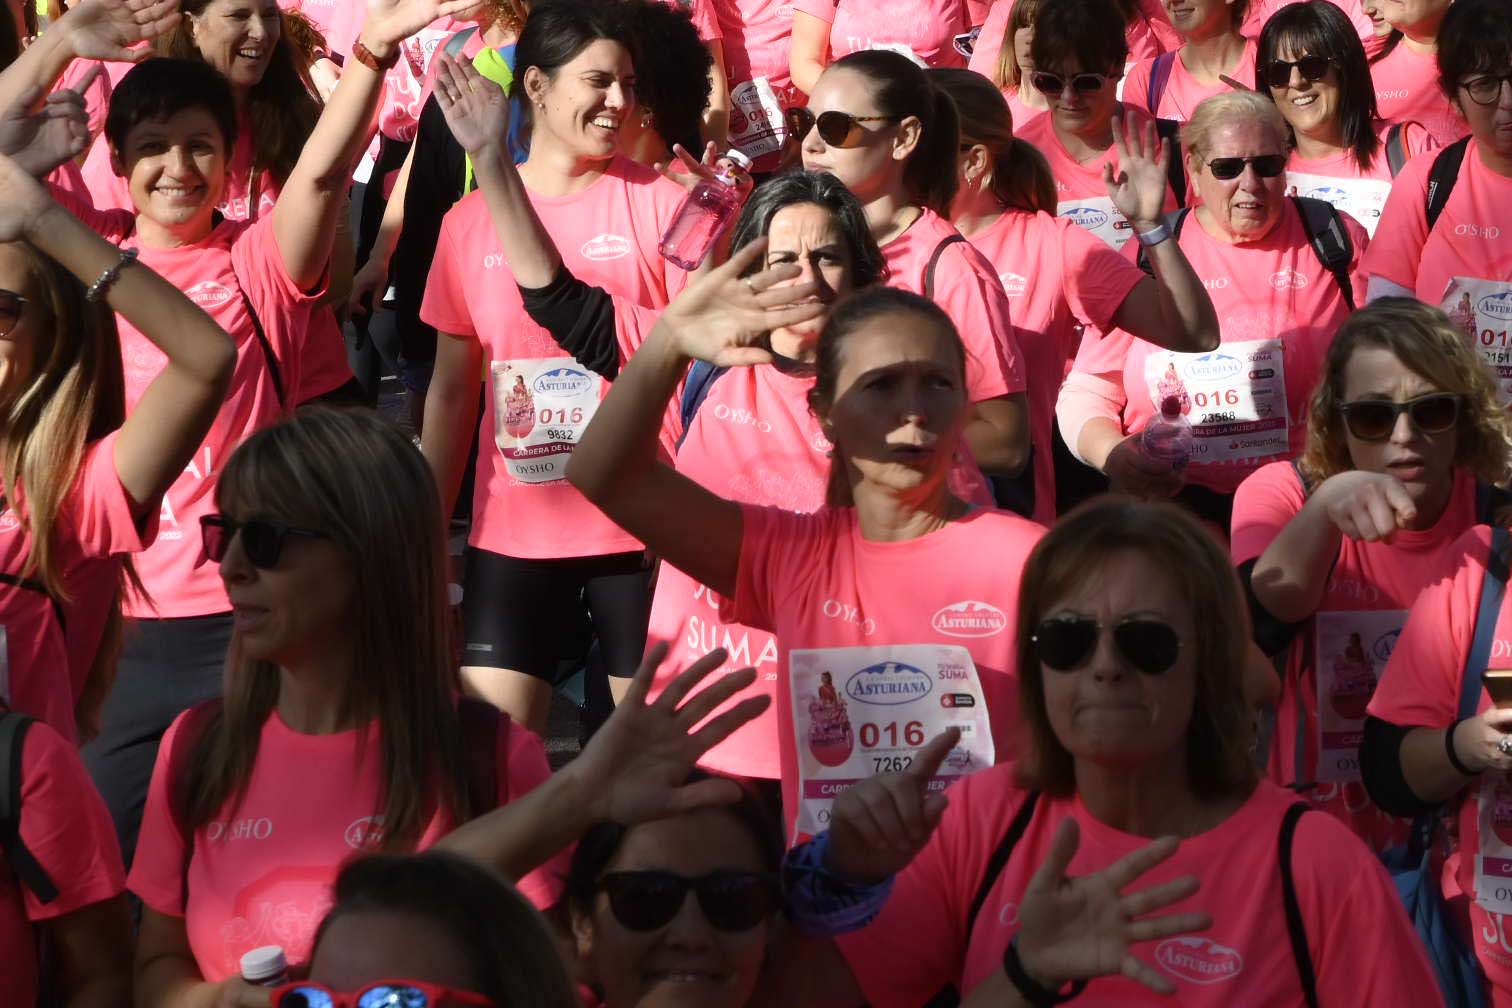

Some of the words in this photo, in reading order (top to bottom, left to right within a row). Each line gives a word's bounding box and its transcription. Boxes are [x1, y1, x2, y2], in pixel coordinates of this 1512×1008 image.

[1373, 88, 1410, 100] YSHO
[539, 380, 582, 392] ASTURIA
[1194, 389, 1240, 408] 016
[540, 407, 584, 425] 016
[547, 429, 574, 441] 9832
[513, 446, 549, 458] CARRERA
[551, 444, 563, 453] DE
[516, 462, 554, 475] OYSHO
[937, 615, 1002, 629] ASTURIANA
[687, 615, 777, 668] SUMA
[938, 669, 969, 681] SUMA
[853, 679, 927, 696] ASTURIANA
[859, 721, 926, 749] 016
[873, 756, 914, 773] 7262
[207, 817, 273, 841] OSHO
[1164, 946, 1236, 974] ASTURIANA
